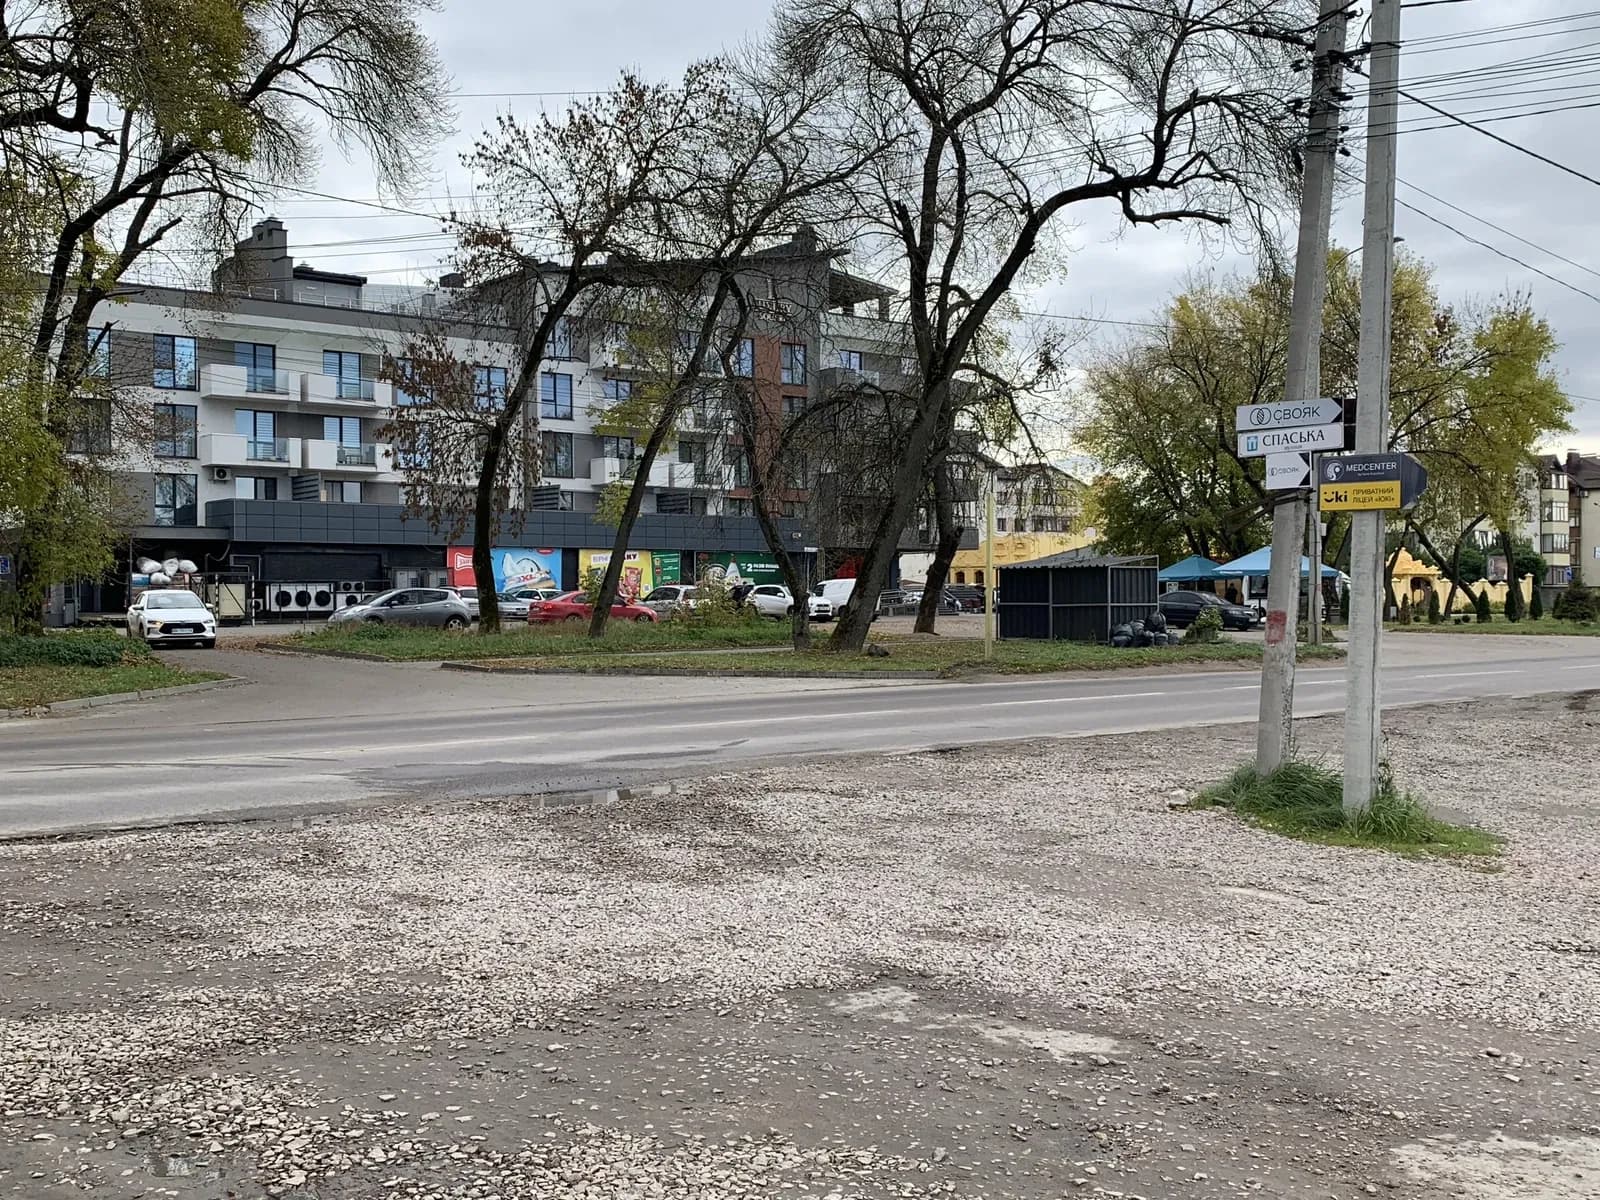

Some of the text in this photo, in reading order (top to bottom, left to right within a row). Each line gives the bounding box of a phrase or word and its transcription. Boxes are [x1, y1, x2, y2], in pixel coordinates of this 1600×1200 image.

[1273, 406, 1321, 421] СВОЯК
[1262, 429, 1325, 447] СПАСЬКА
[1346, 461, 1397, 472] MEDCENTER
[1352, 486, 1394, 496] ПРИВАТНИЙ
[1352, 495, 1374, 504] ЛІЦЕЙ
